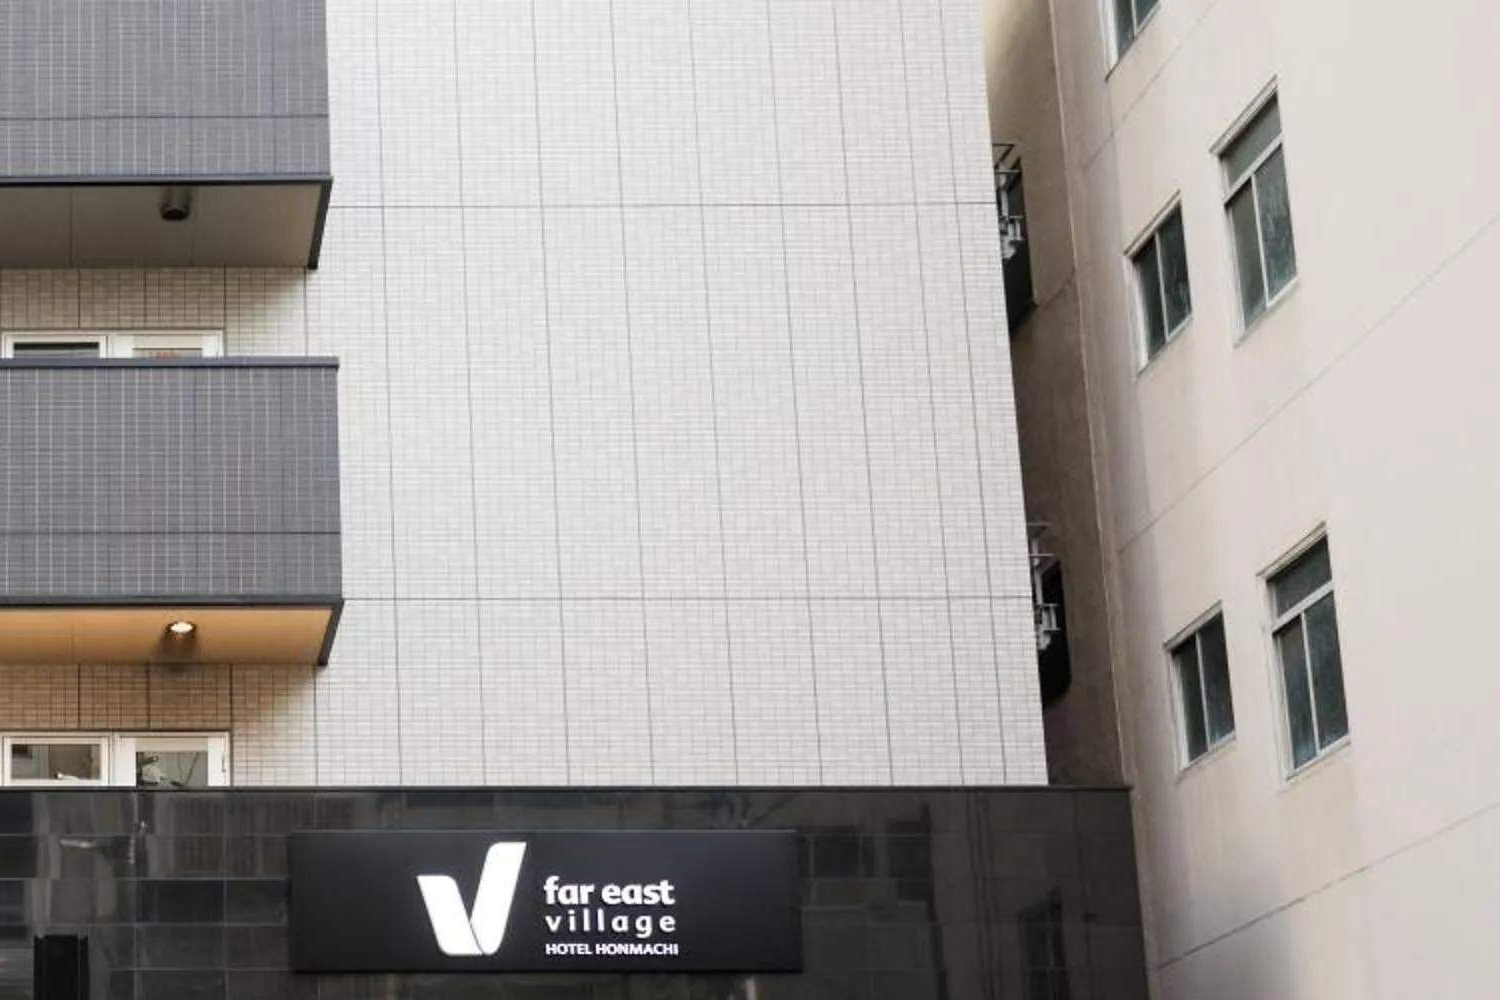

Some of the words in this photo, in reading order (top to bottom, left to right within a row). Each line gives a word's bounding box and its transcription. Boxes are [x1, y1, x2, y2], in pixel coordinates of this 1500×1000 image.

[543, 875, 595, 905] far
[601, 879, 676, 905] east
[545, 907, 676, 938] village
[545, 943, 593, 955] HOTEL
[595, 943, 679, 956] HONMACHI
